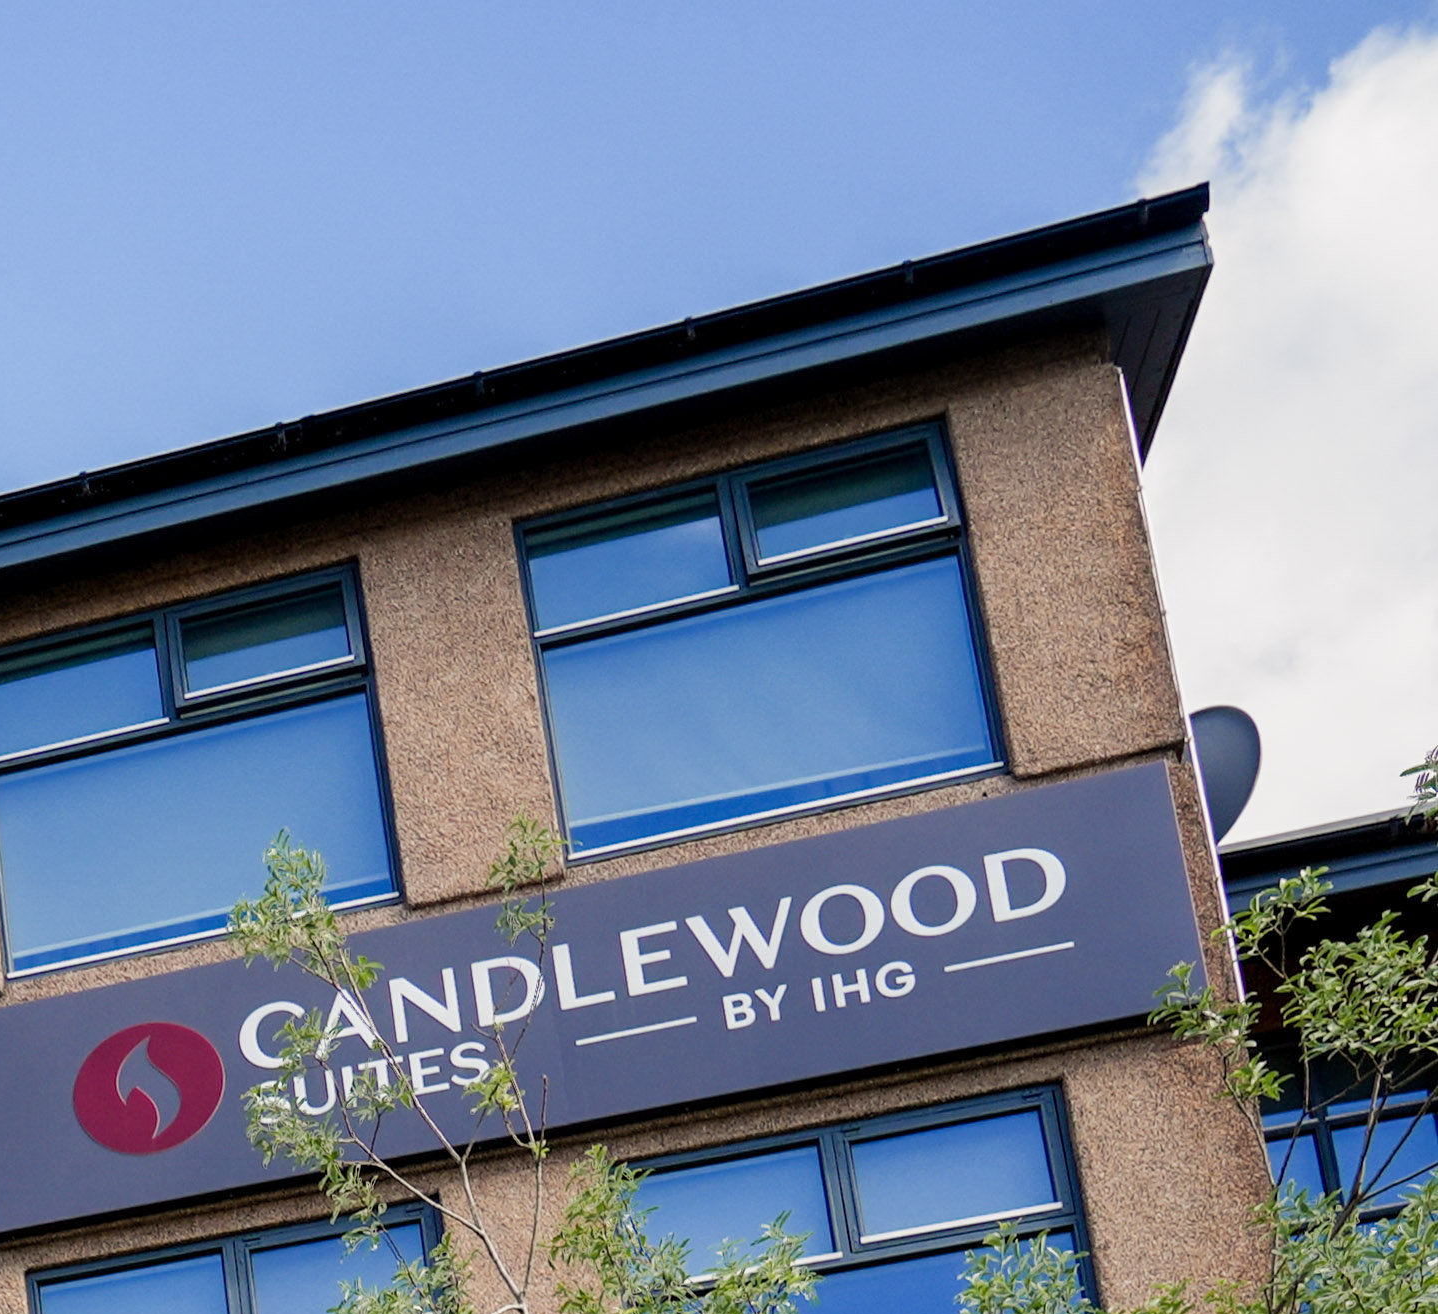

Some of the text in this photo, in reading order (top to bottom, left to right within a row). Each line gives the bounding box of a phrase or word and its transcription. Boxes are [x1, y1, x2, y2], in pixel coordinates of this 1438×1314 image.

[239, 847, 1067, 1068] CANDLEWOOD
[722, 961, 917, 1031] BY IHG
